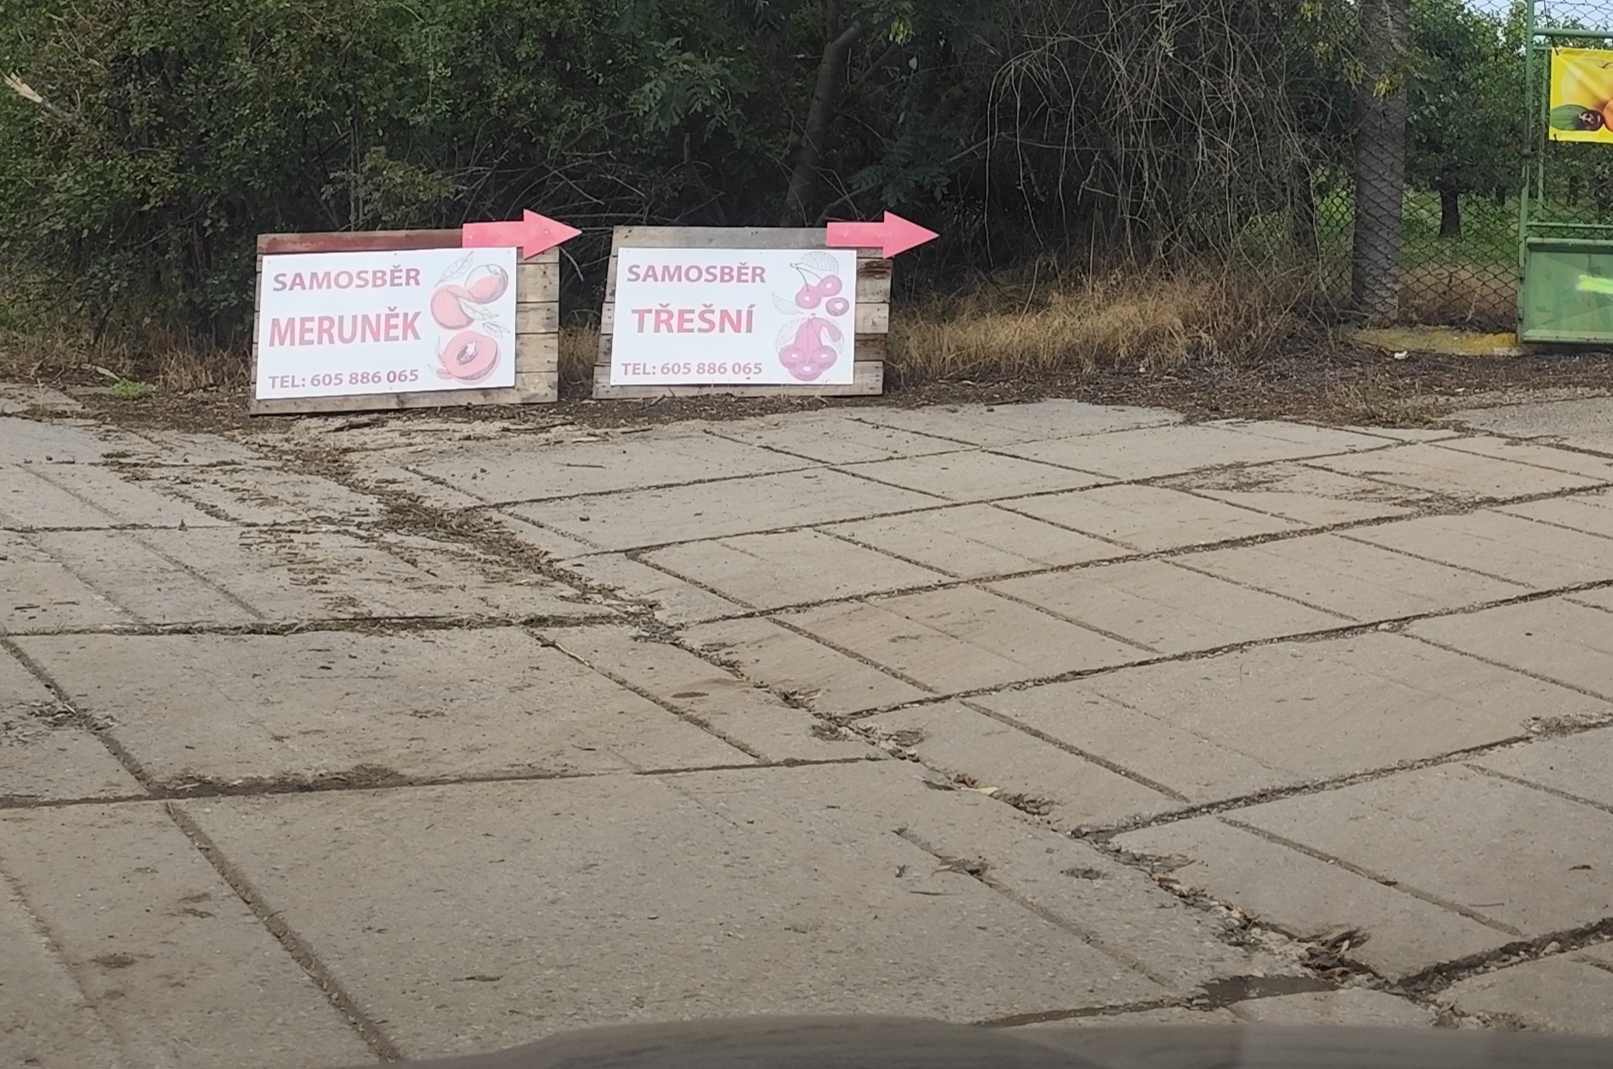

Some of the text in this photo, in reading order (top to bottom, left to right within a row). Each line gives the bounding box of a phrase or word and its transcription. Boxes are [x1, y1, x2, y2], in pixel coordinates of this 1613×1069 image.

[272, 264, 421, 292] SAMOSBĚR
[626, 261, 766, 284] SAMOSBĚR
[268, 306, 422, 347] MERUNĚK
[631, 303, 757, 334] TŘEŠNÍ
[268, 368, 420, 389] TEL: 605 886 065
[621, 362, 763, 376] TEL: 605 886 065
